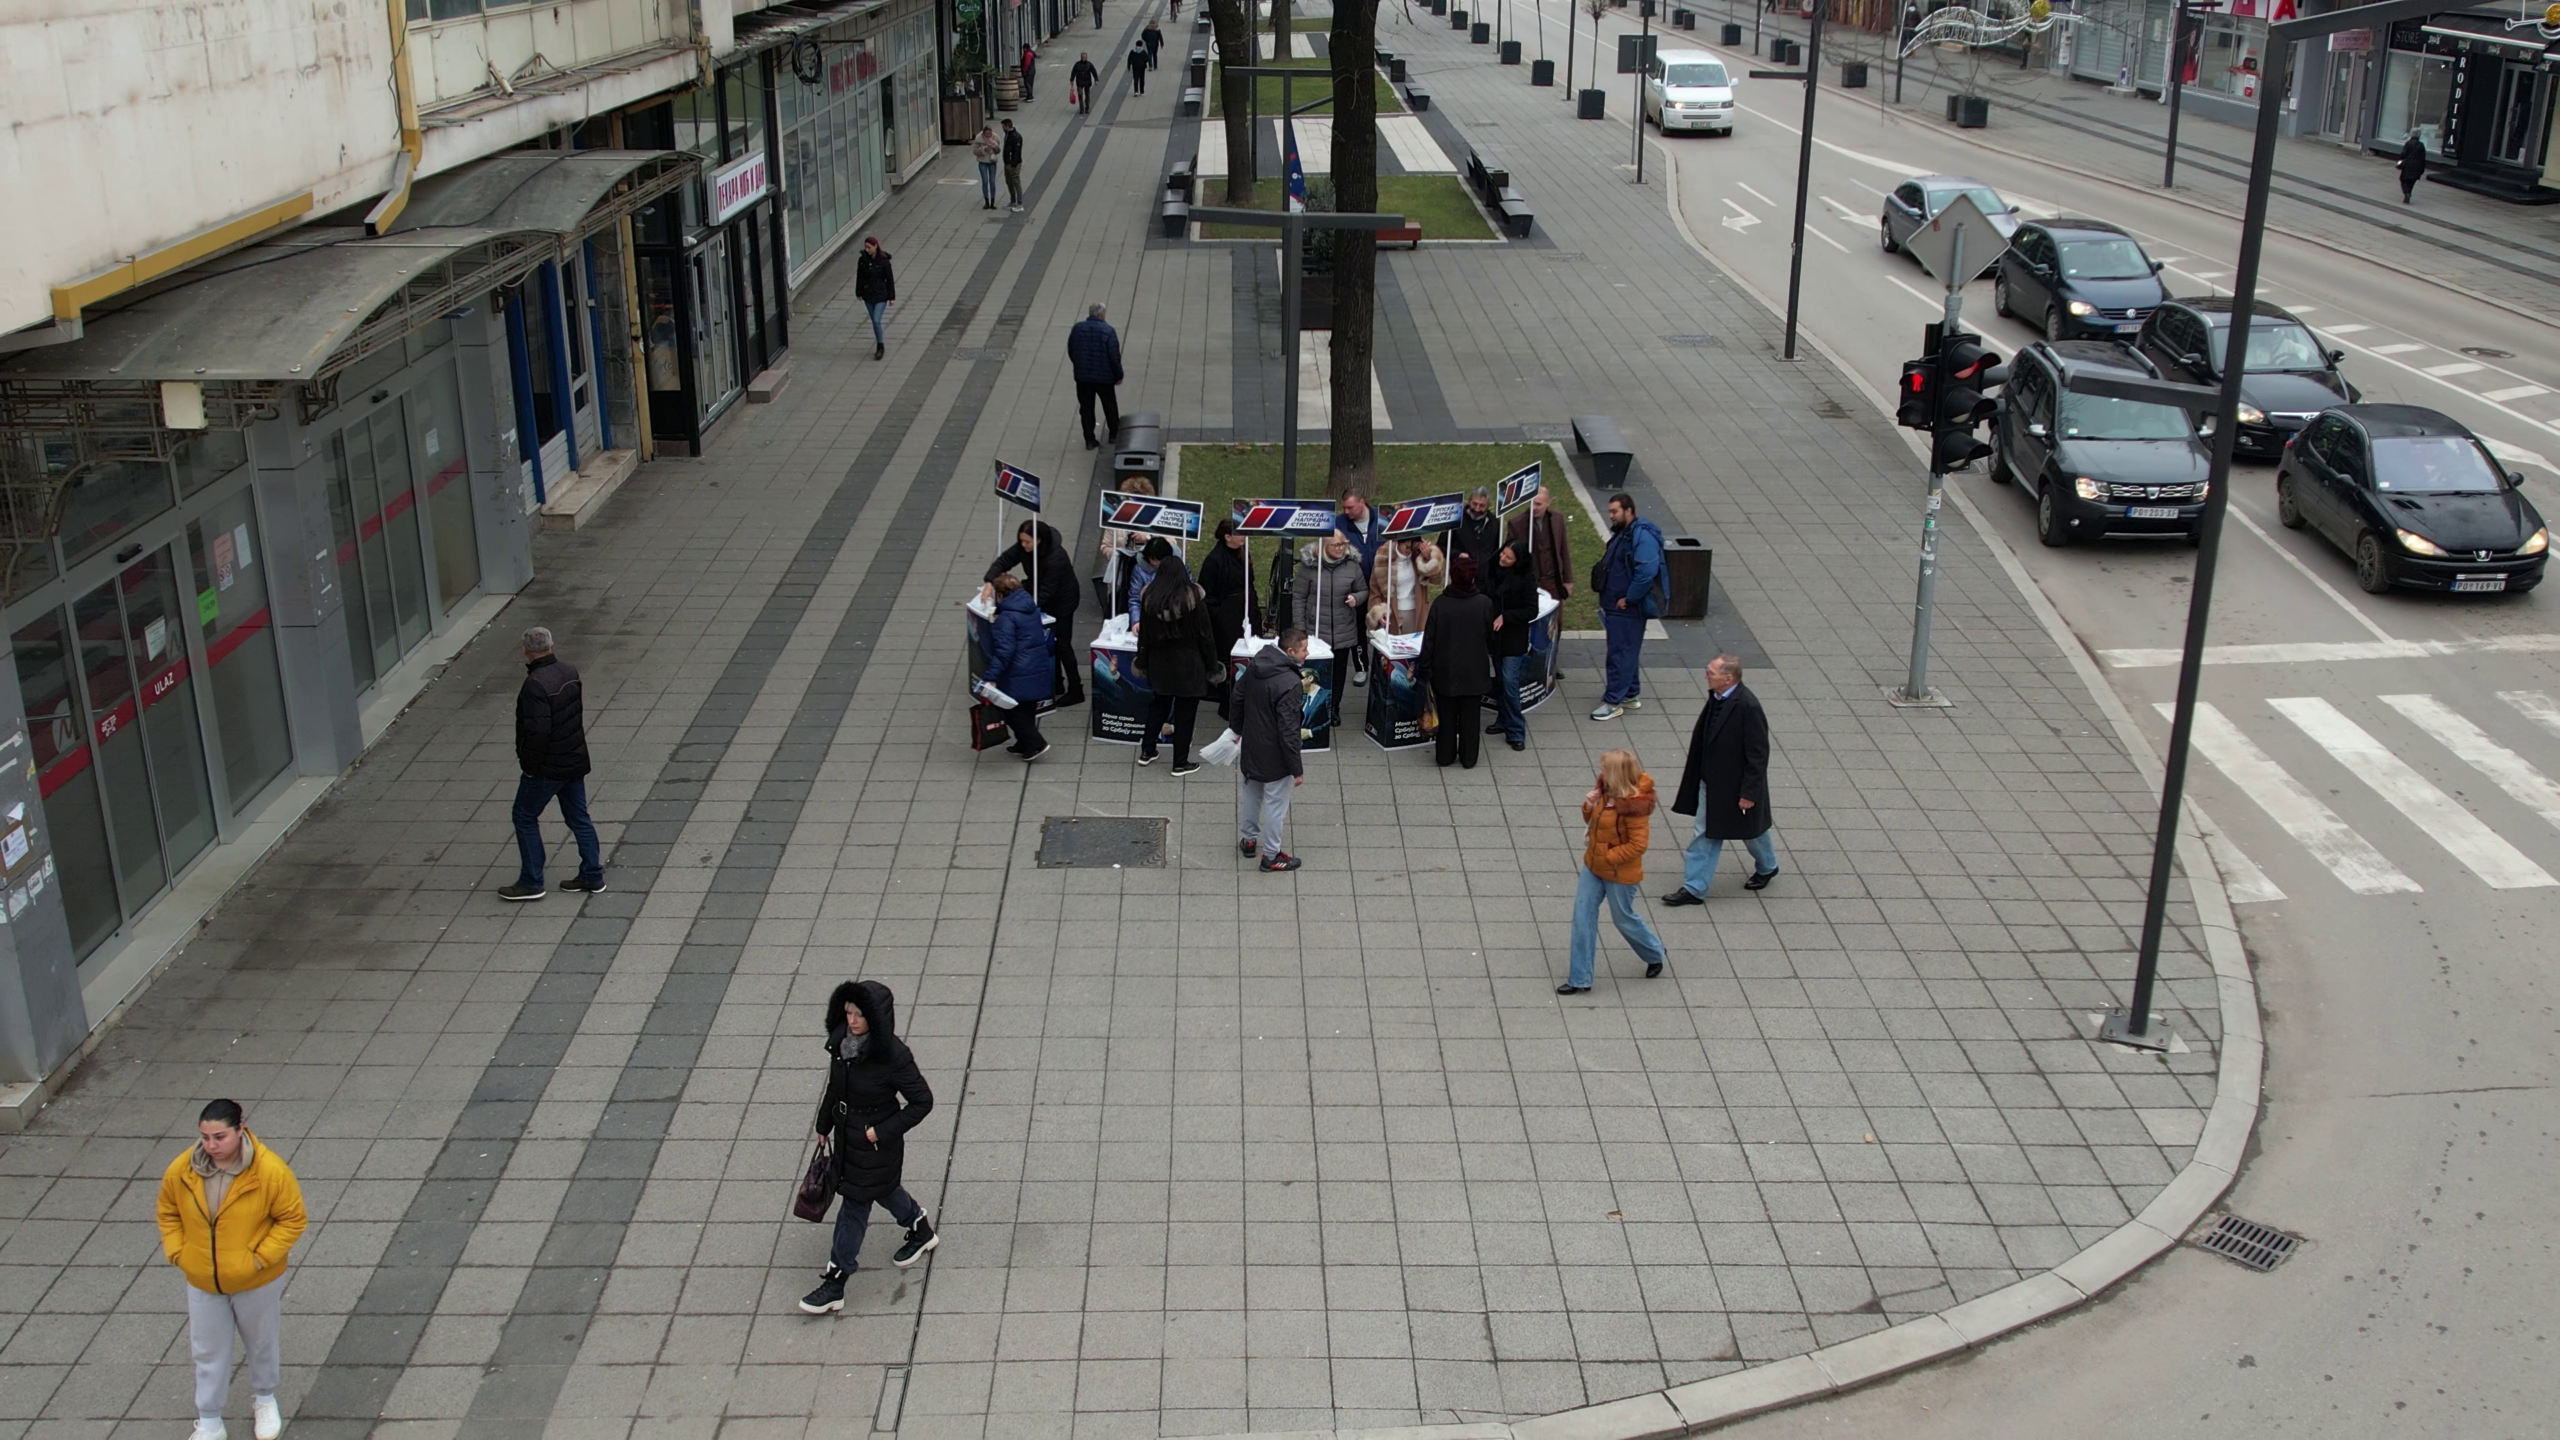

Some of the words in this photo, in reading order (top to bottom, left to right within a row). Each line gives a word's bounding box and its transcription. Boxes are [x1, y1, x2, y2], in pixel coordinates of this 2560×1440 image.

[2396, 30, 2420, 43] STORE
[718, 177, 739, 212] ПЕКАРА
[755, 161, 764, 194] ДАН
[154, 672, 174, 695] ULAZ
[1102, 719, 1123, 728] Србија
[1394, 726, 1415, 734] Србија
